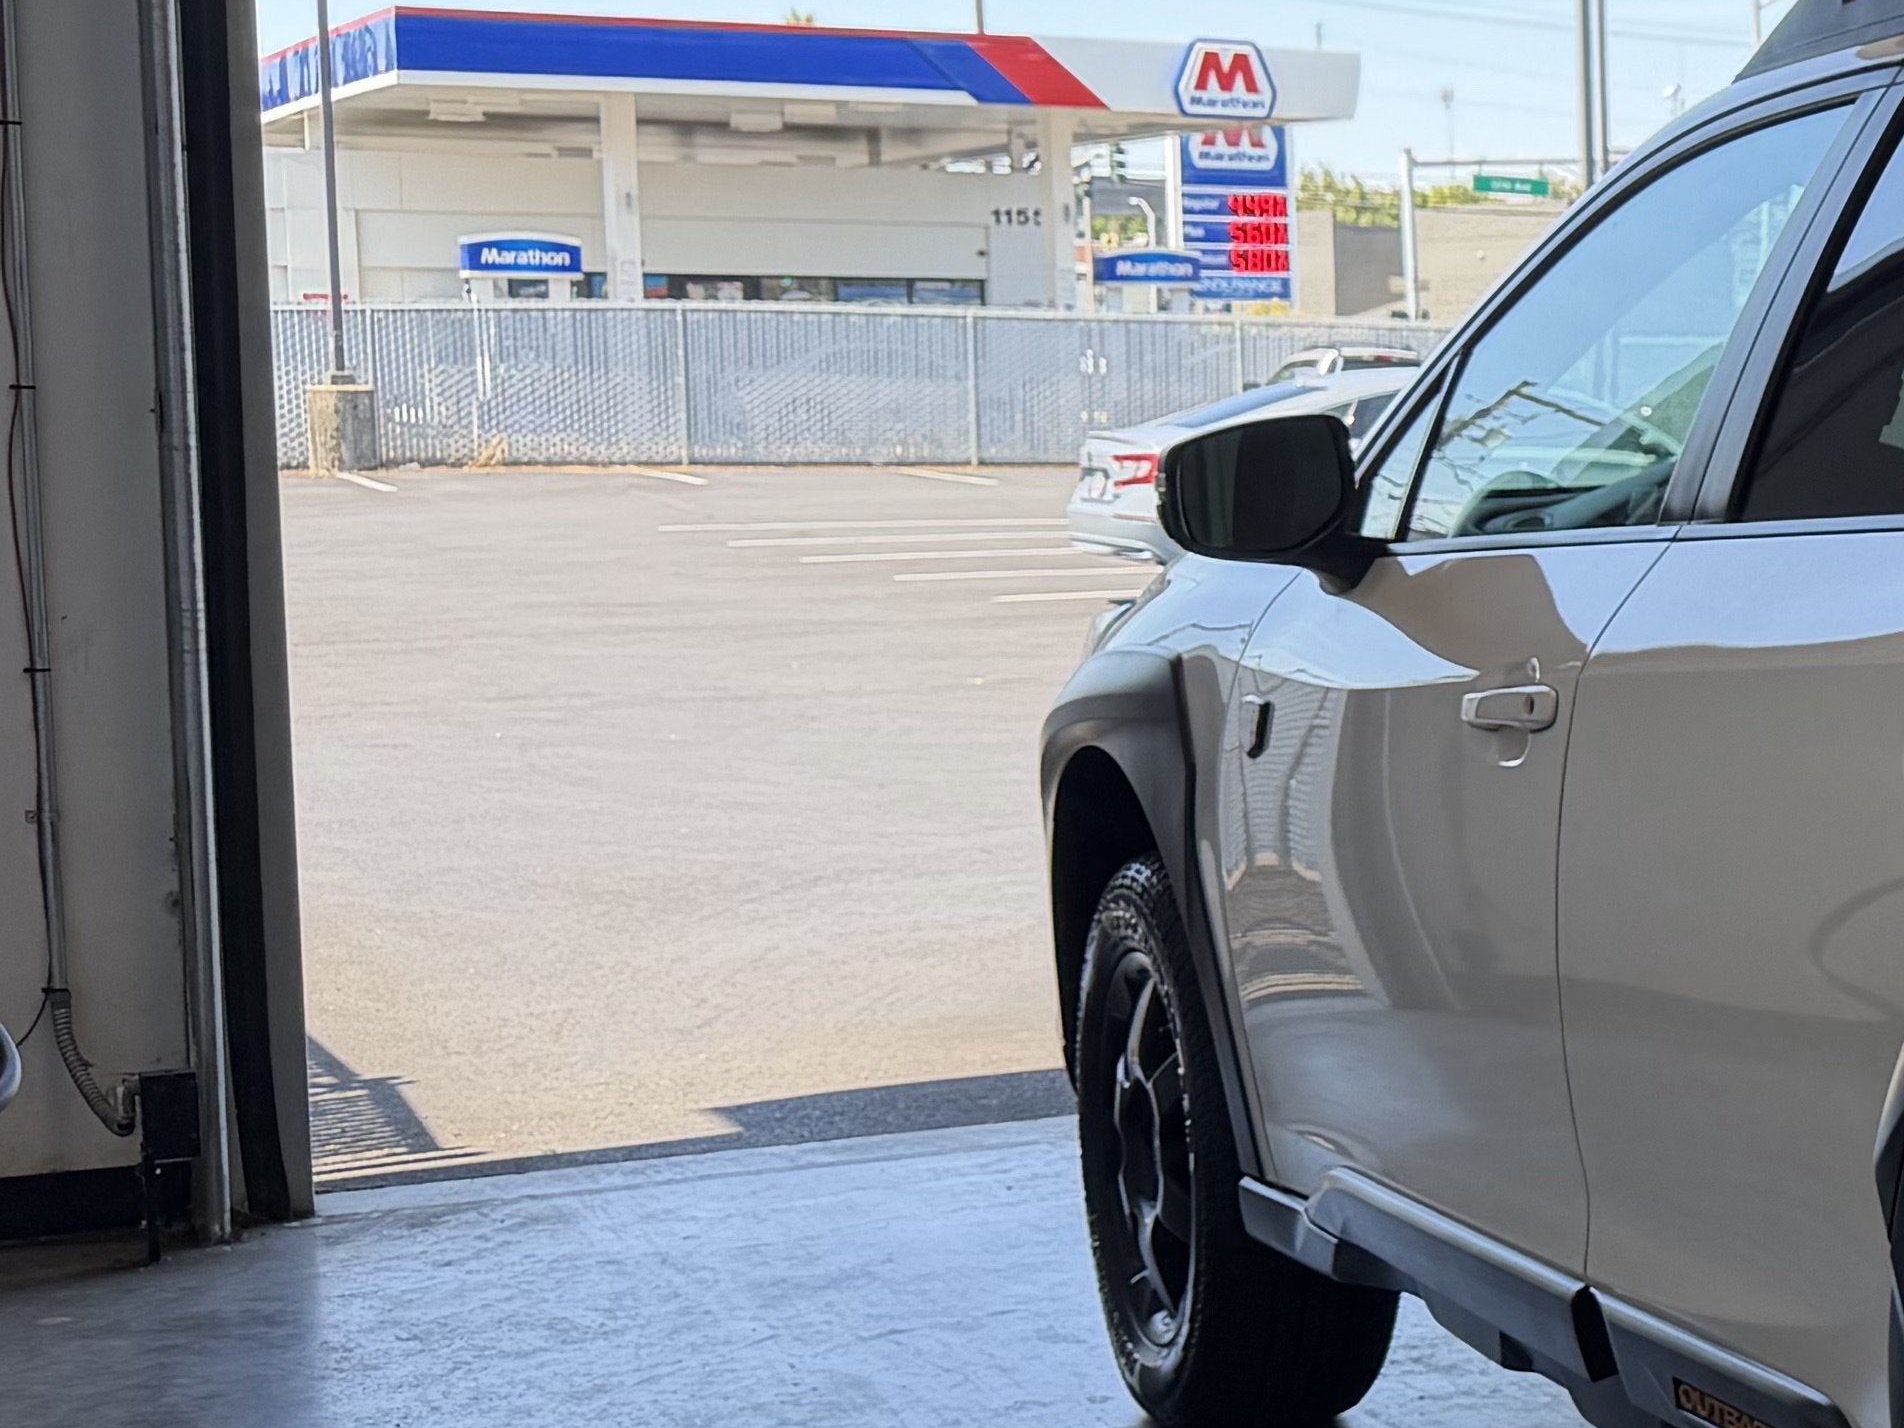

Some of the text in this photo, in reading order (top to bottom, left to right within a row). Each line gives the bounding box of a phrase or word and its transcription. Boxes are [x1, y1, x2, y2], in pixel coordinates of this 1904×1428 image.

[1193, 51, 1260, 93] M
[481, 247, 571, 266] Marathon
[1115, 260, 1194, 277] Marathon
